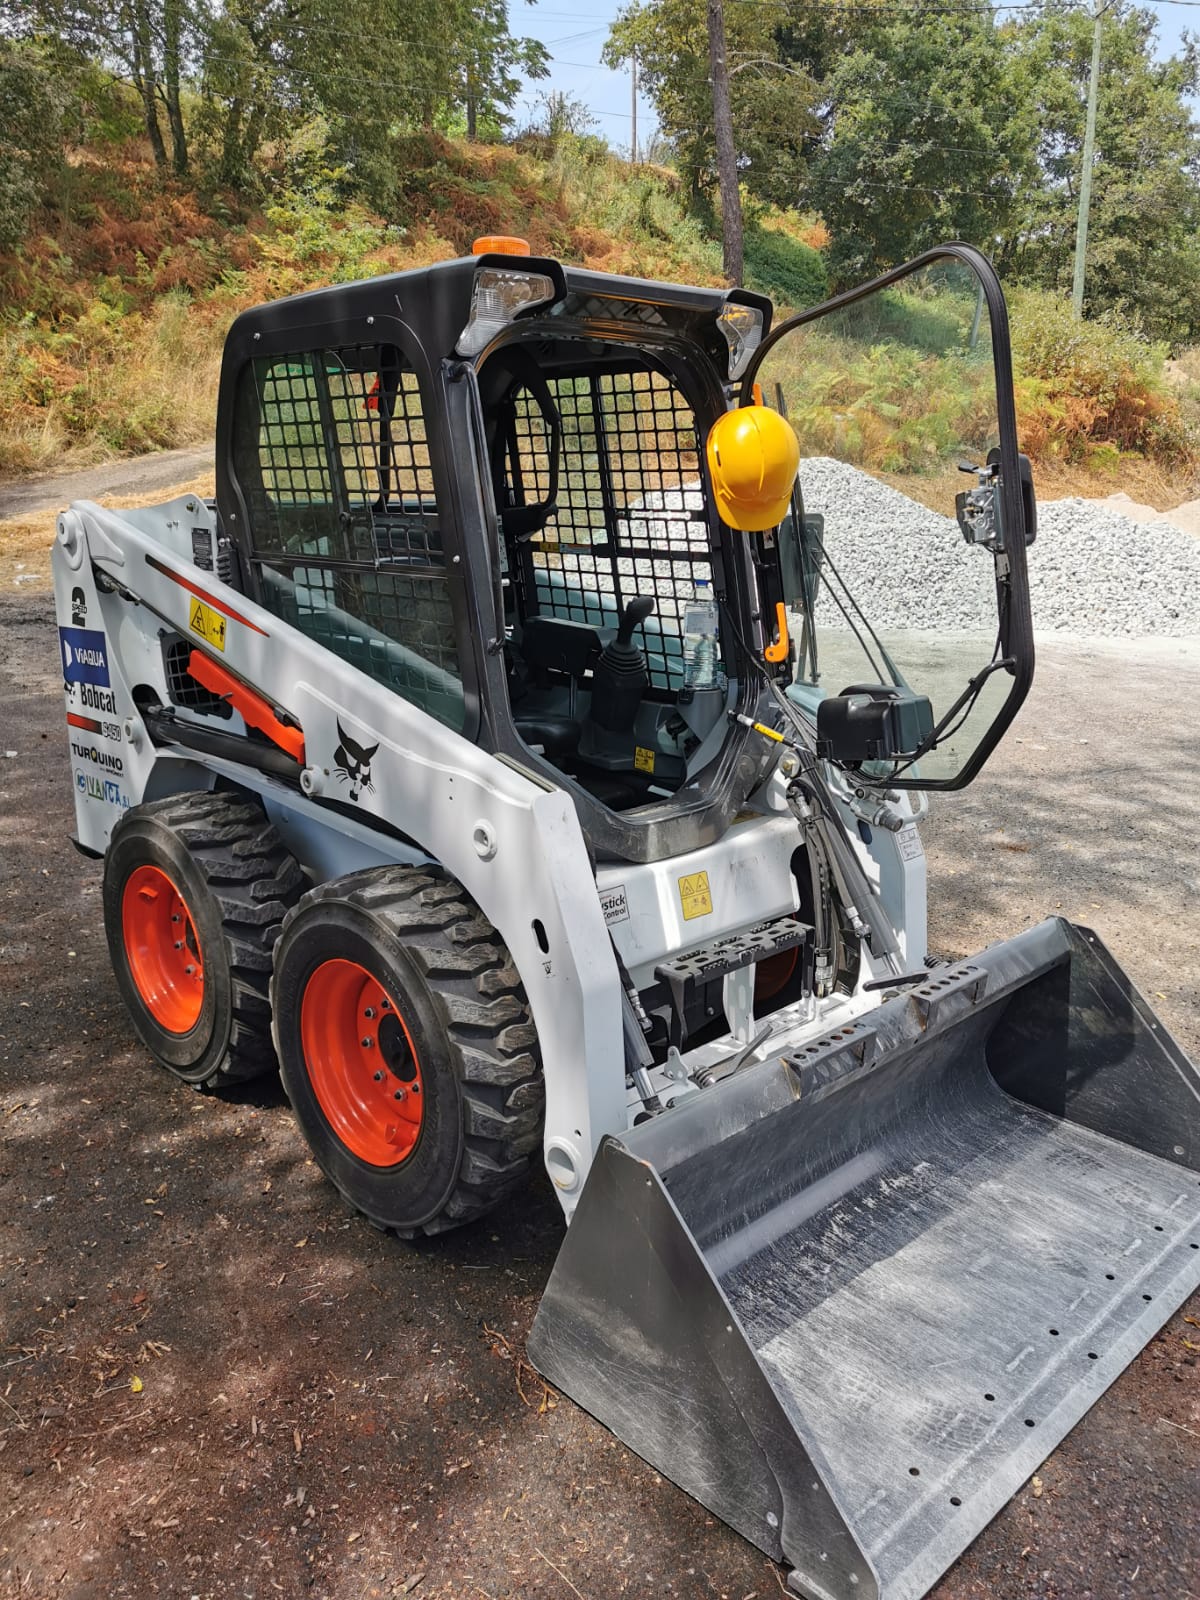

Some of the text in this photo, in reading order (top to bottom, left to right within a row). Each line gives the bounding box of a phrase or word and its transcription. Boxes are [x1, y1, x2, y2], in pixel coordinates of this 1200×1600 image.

[72, 586, 85, 627] 2
[72, 603, 87, 614] SPEED
[81, 682, 117, 715] Bobcat
[71, 743, 123, 771] TURQUINO
